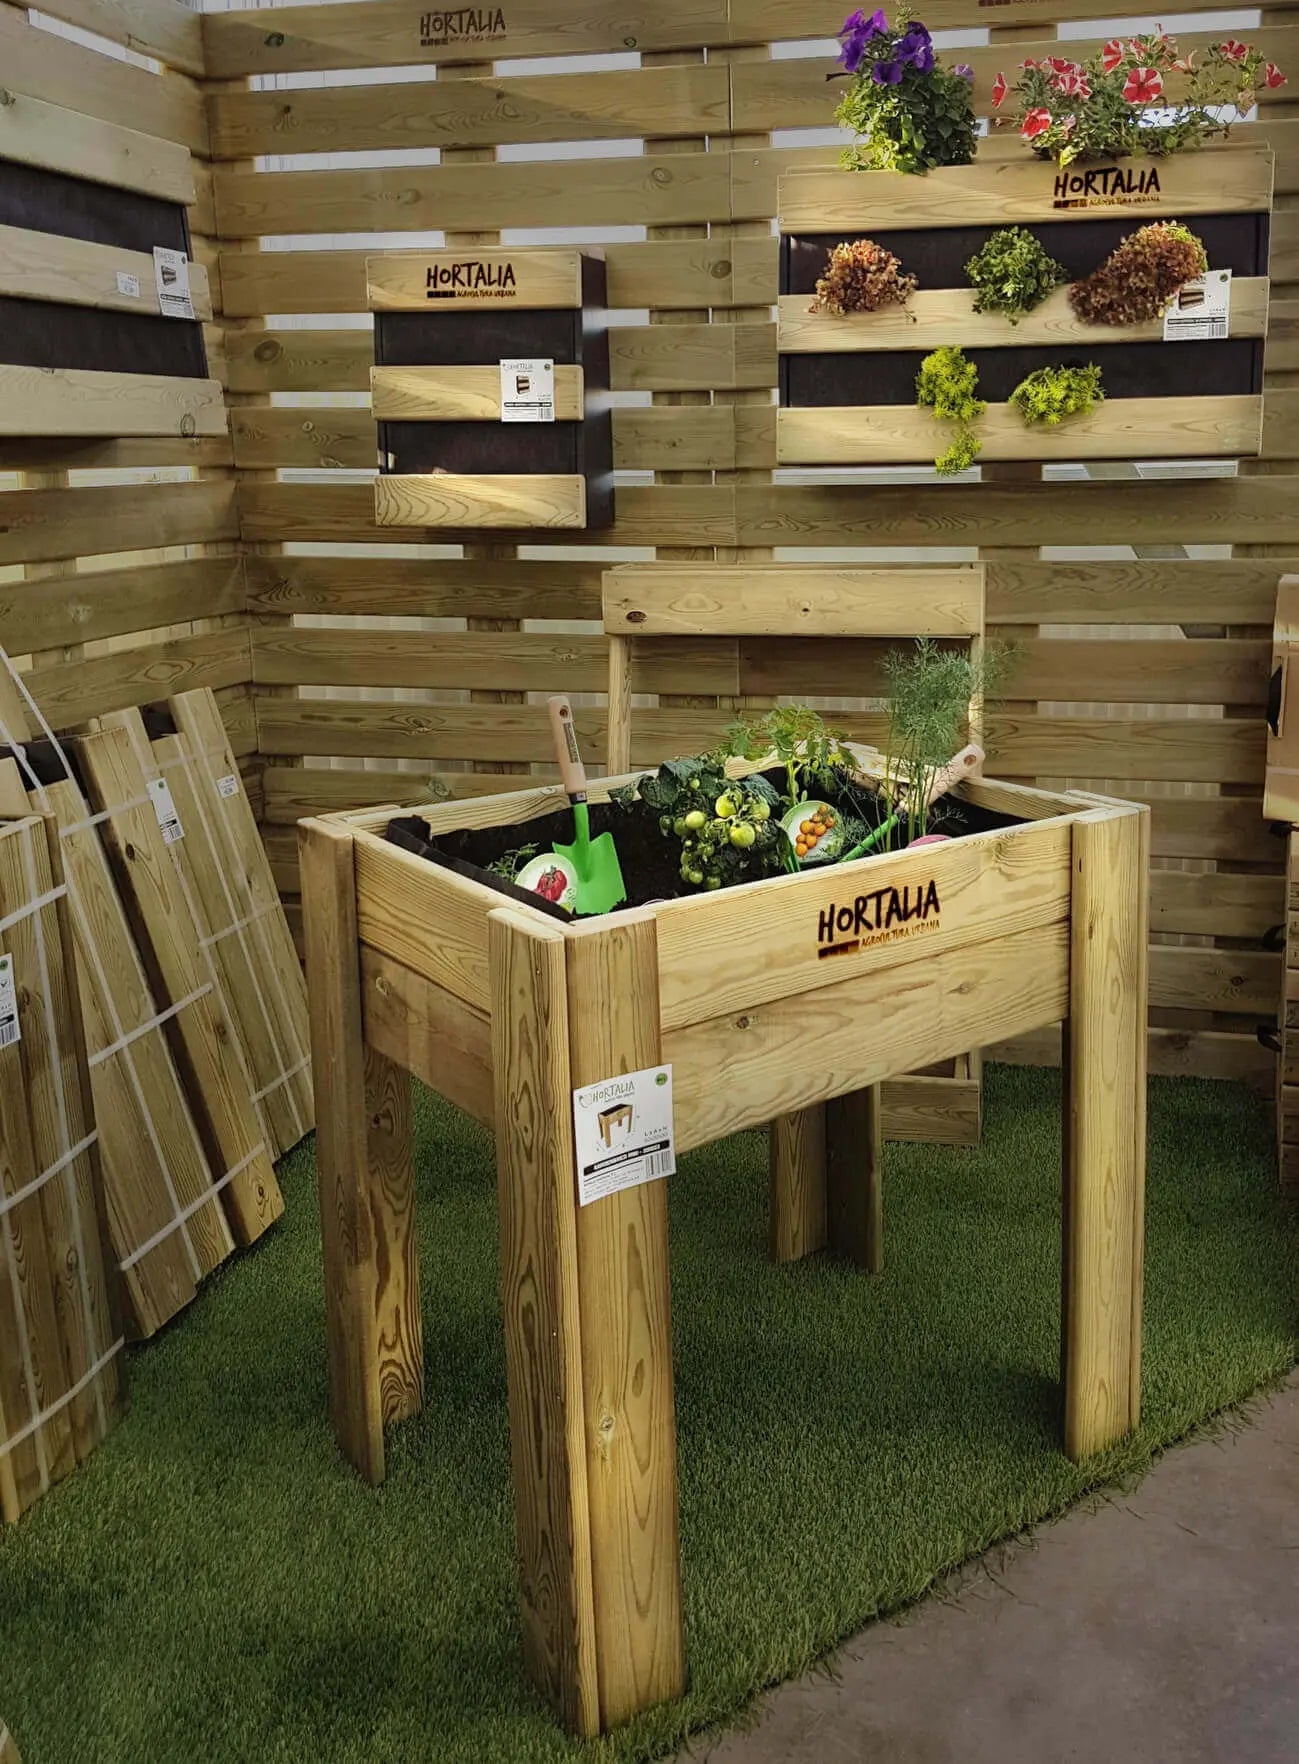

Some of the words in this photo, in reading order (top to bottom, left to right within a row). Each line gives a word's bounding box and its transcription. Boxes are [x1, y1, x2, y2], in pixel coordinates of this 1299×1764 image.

[420, 8, 506, 37] HORTALIA
[1054, 167, 1160, 198] HORTALIA
[426, 262, 516, 289] HORTALIA
[818, 880, 940, 943] HORTALIA
[593, 1081, 636, 1102] HORTALIA
